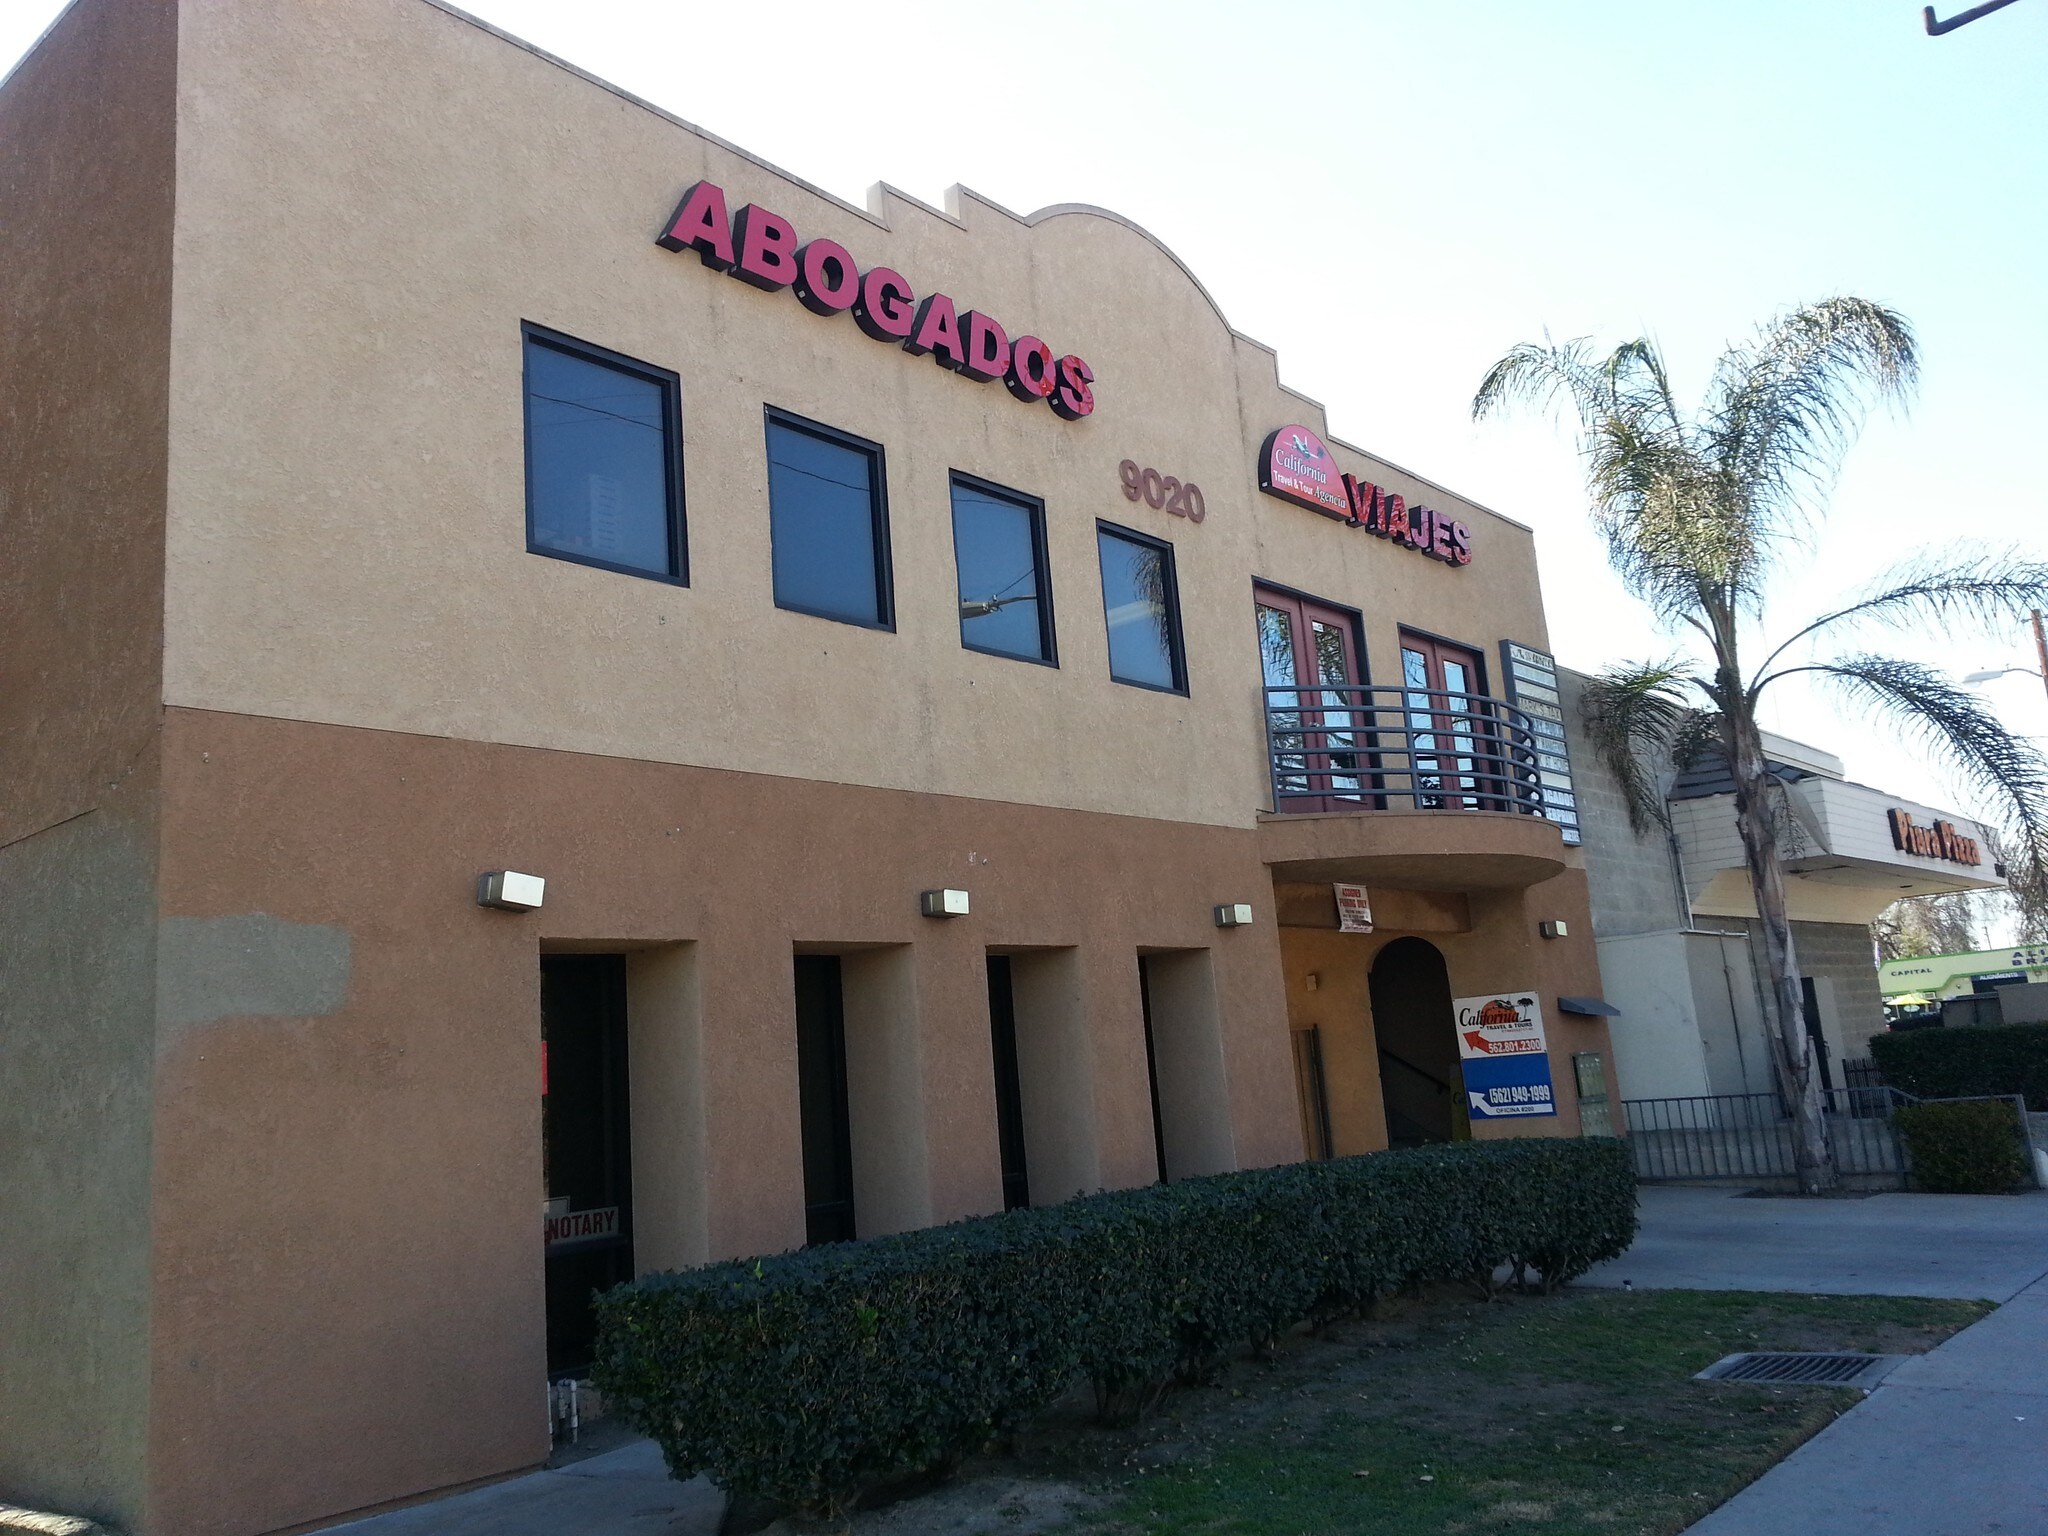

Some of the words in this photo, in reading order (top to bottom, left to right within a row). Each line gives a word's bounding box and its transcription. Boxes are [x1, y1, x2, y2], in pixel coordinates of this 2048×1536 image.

[658, 180, 1095, 420] ABOGADOS
[1275, 449, 1327, 485] California
[1119, 459, 1205, 524] 9020
[1273, 470, 1293, 487] Travel
[1293, 479, 1299, 490] &
[1299, 480, 1314, 495] Tour
[1314, 486, 1346, 509] Agencia
[1342, 473, 1472, 567] VIAJES
[1891, 968, 1932, 976] CAPITAL
[1459, 1008, 1520, 1029] California
[1488, 1039, 1541, 1053] 562.801.2300
[548, 1210, 615, 1240] NOTARY
